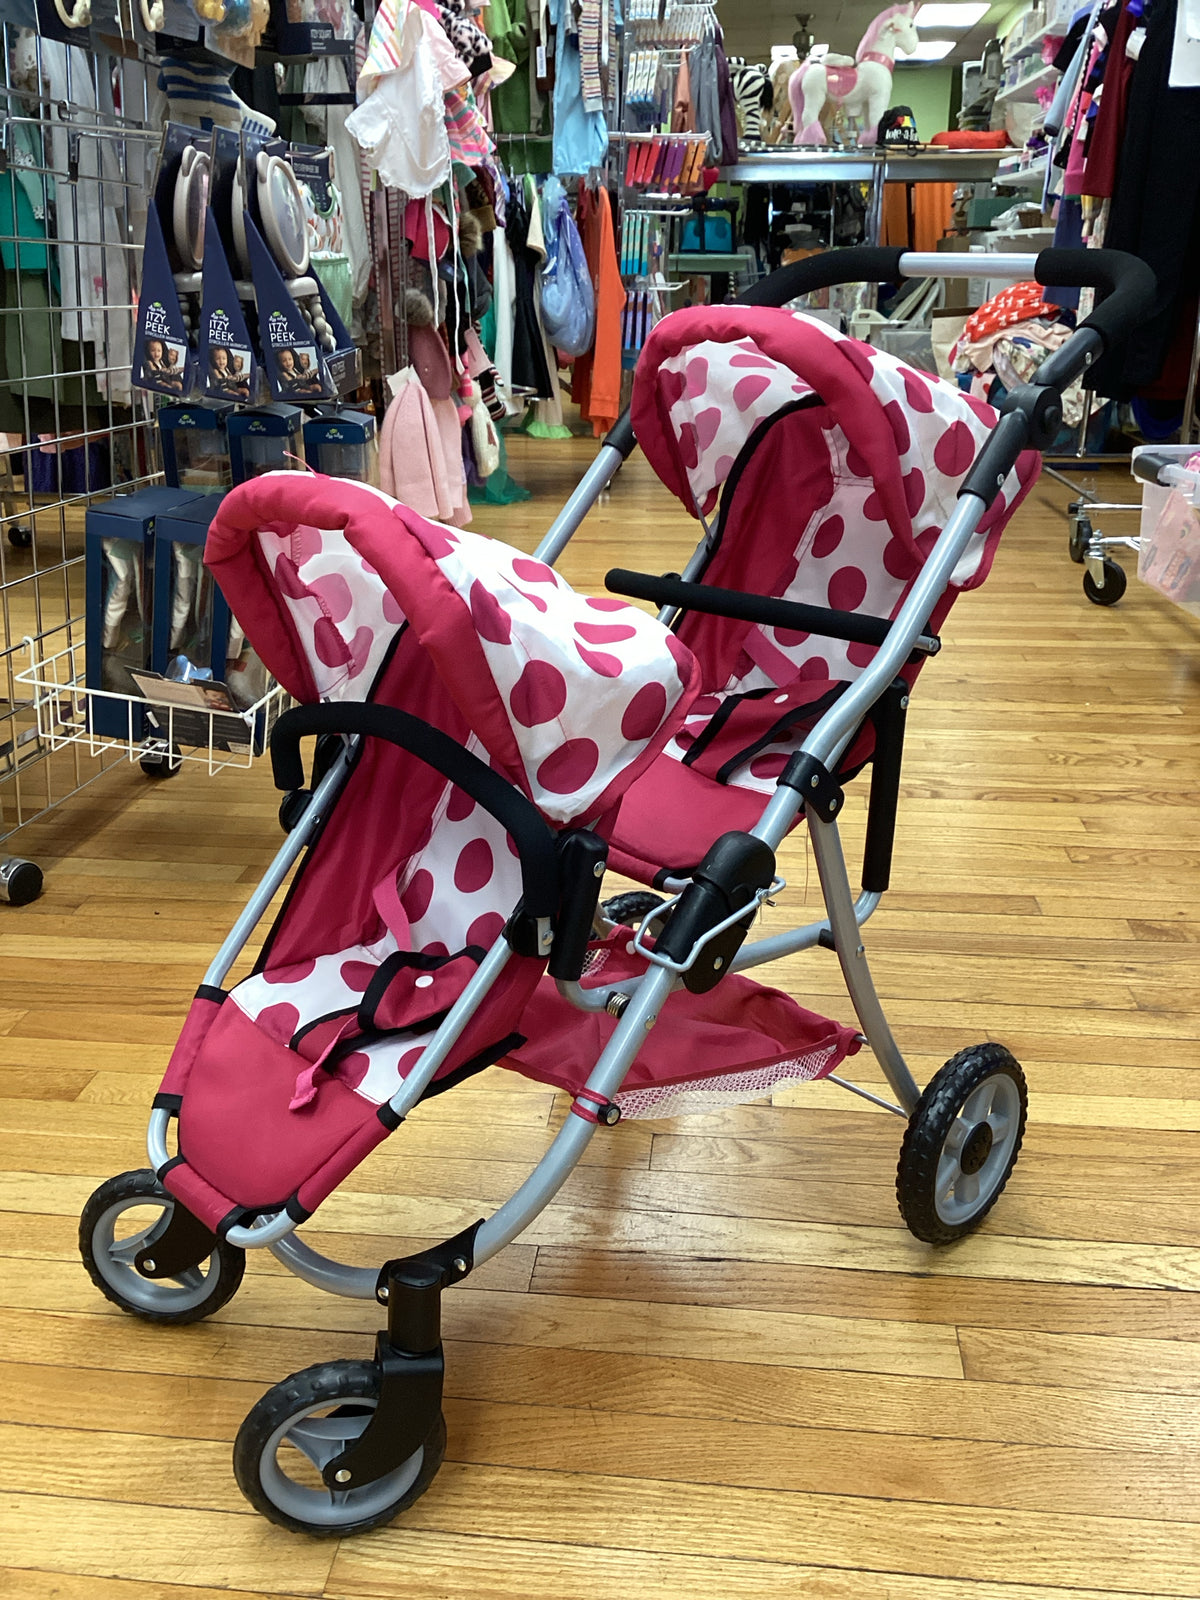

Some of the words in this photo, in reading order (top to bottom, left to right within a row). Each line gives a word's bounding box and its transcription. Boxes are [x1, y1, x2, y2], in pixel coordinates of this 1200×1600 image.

[146, 311, 167, 324] ITZY
[144, 320, 171, 336] PEEK
[209, 319, 230, 331] ITZY
[268, 321, 289, 333] ITZY
[208, 329, 235, 343] PEEK
[270, 331, 297, 343] PEEK
